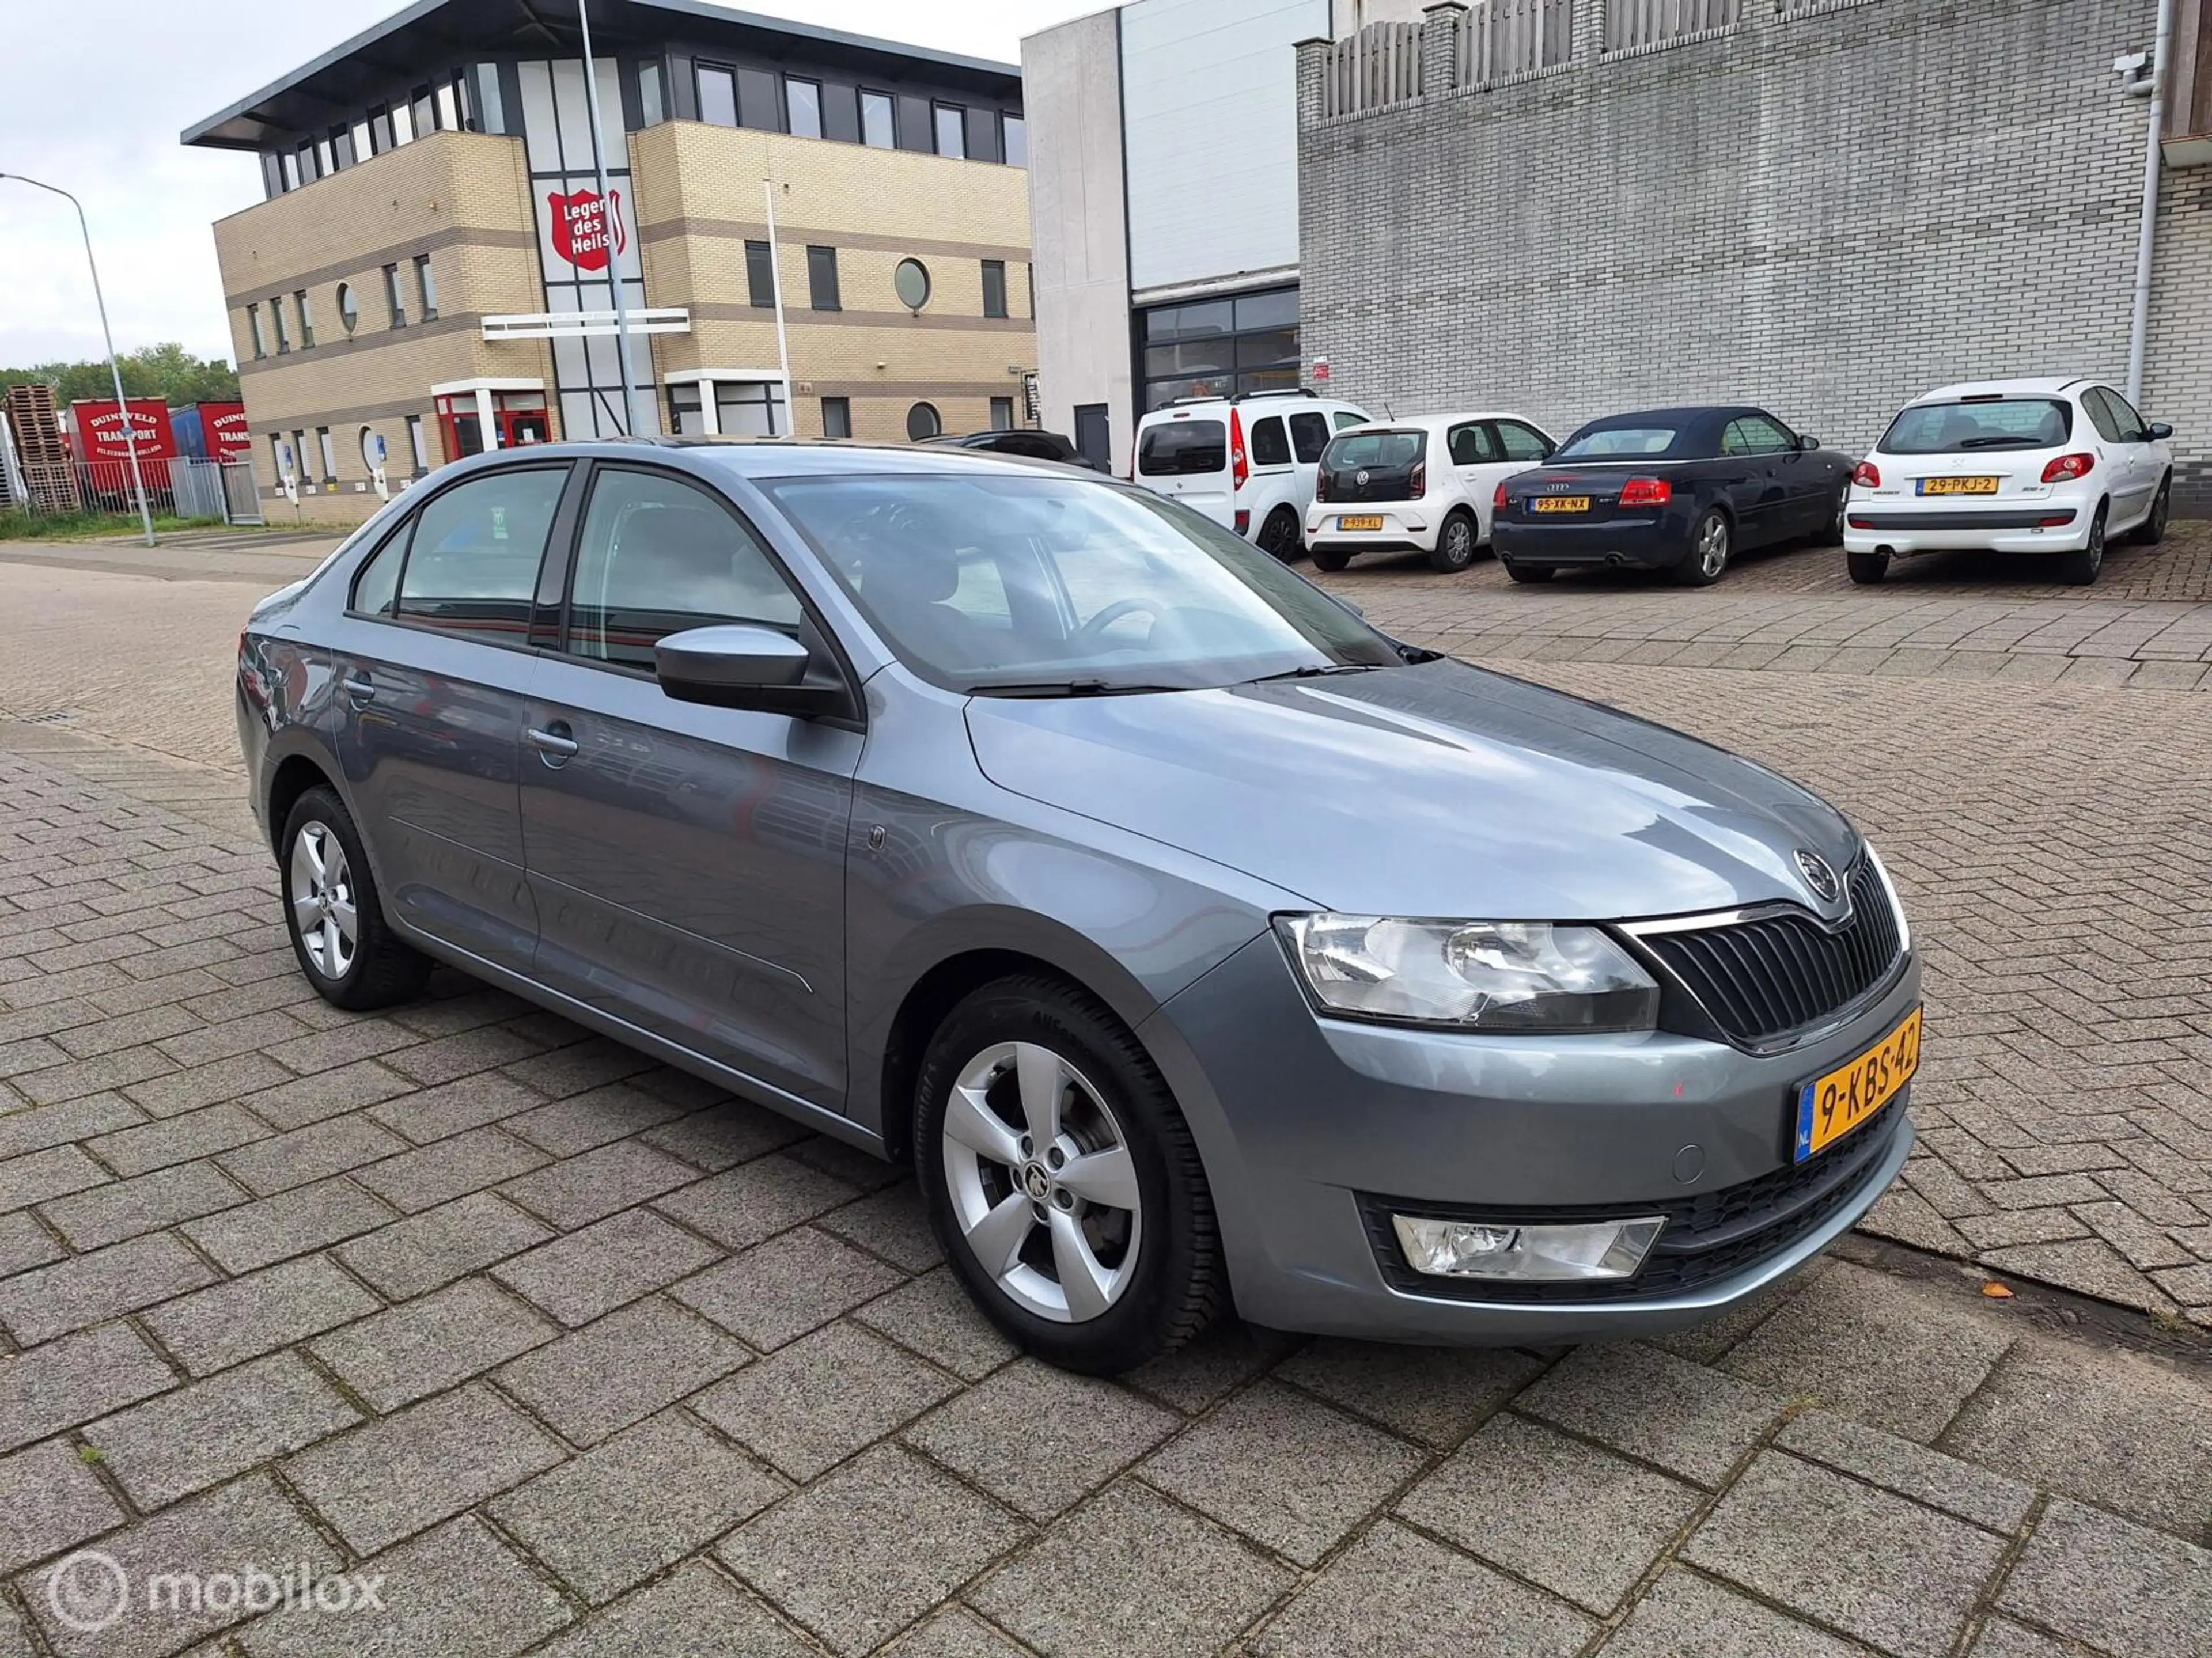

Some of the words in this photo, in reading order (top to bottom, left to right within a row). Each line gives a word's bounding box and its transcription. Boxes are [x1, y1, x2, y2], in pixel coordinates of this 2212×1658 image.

[563, 199, 605, 221] Leger
[574, 219, 601, 236] des
[571, 232, 611, 255] Heils
[95, 428, 157, 442] TRANPORT
[1930, 479, 1991, 491] 29-PKJ-2
[1537, 499, 1585, 509] 95-XK-NX
[1821, 1022, 1915, 1136] 9-KBS-42
[1798, 1130, 1810, 1148] NL
